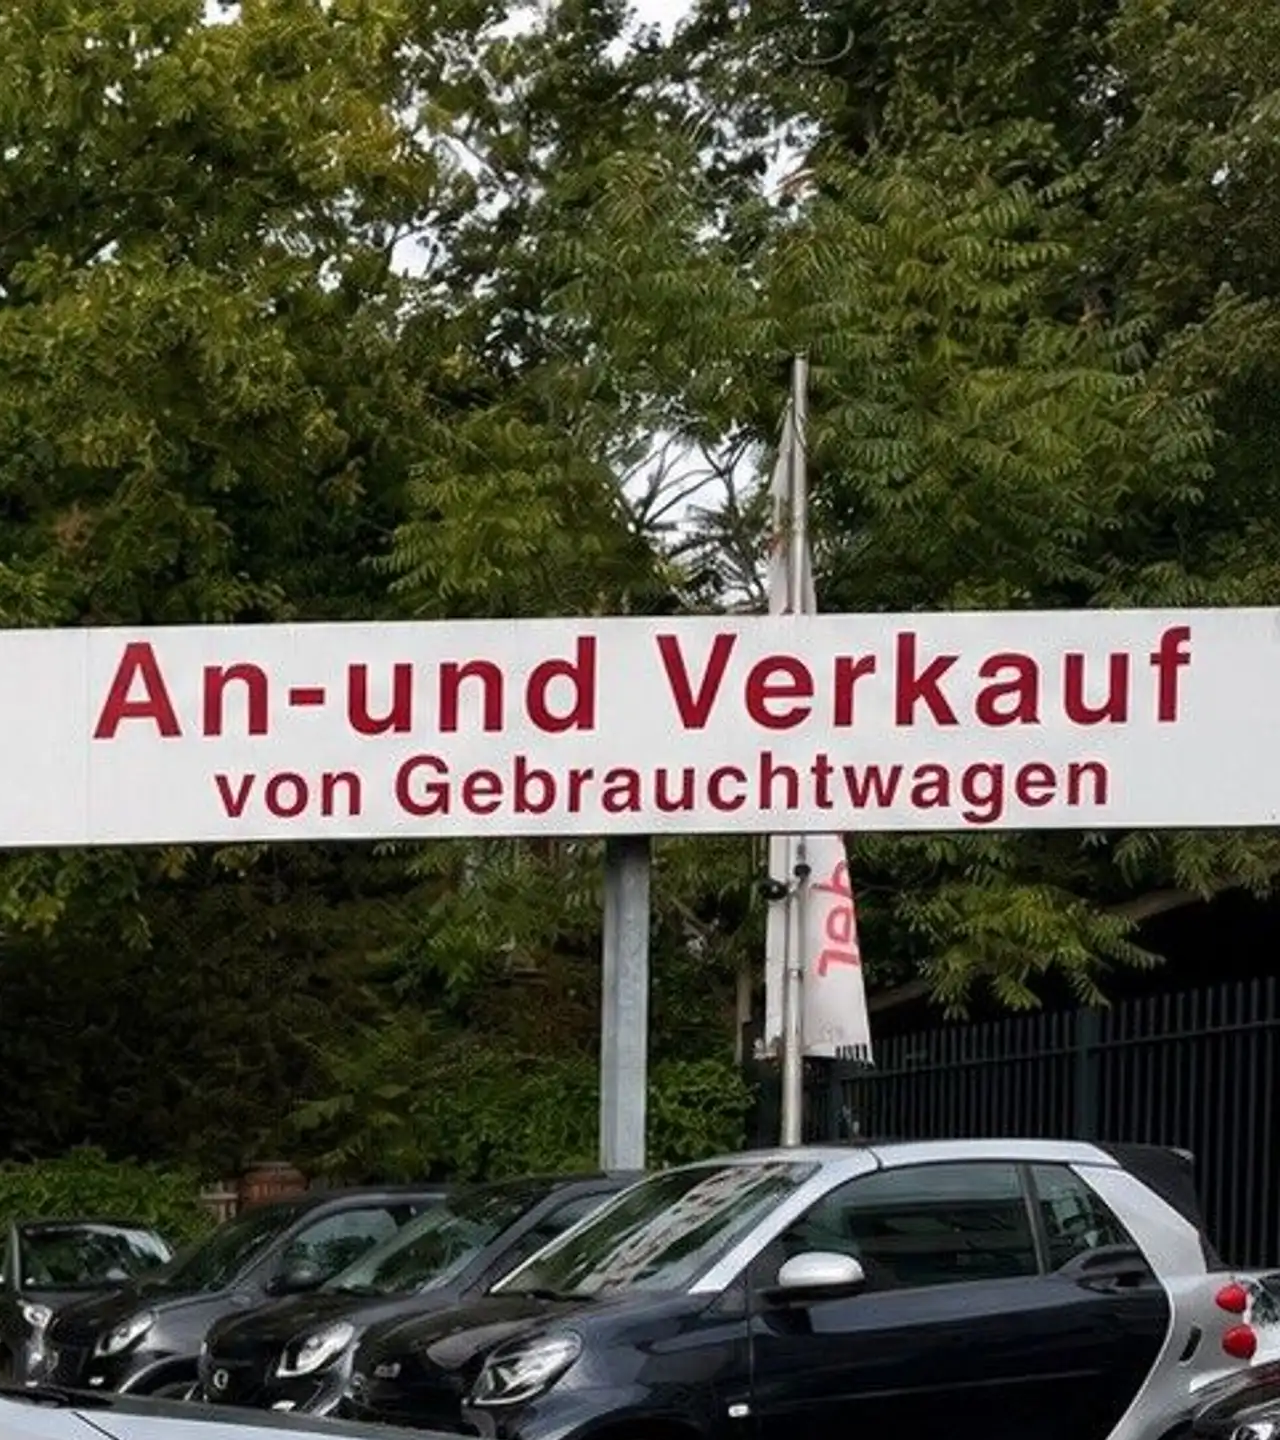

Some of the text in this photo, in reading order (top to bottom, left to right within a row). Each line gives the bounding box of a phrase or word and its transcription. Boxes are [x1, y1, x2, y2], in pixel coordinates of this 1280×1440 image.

[96, 626, 1191, 740] An-und Verkauf
[216, 752, 1109, 826] von Gebrauchtwagen
